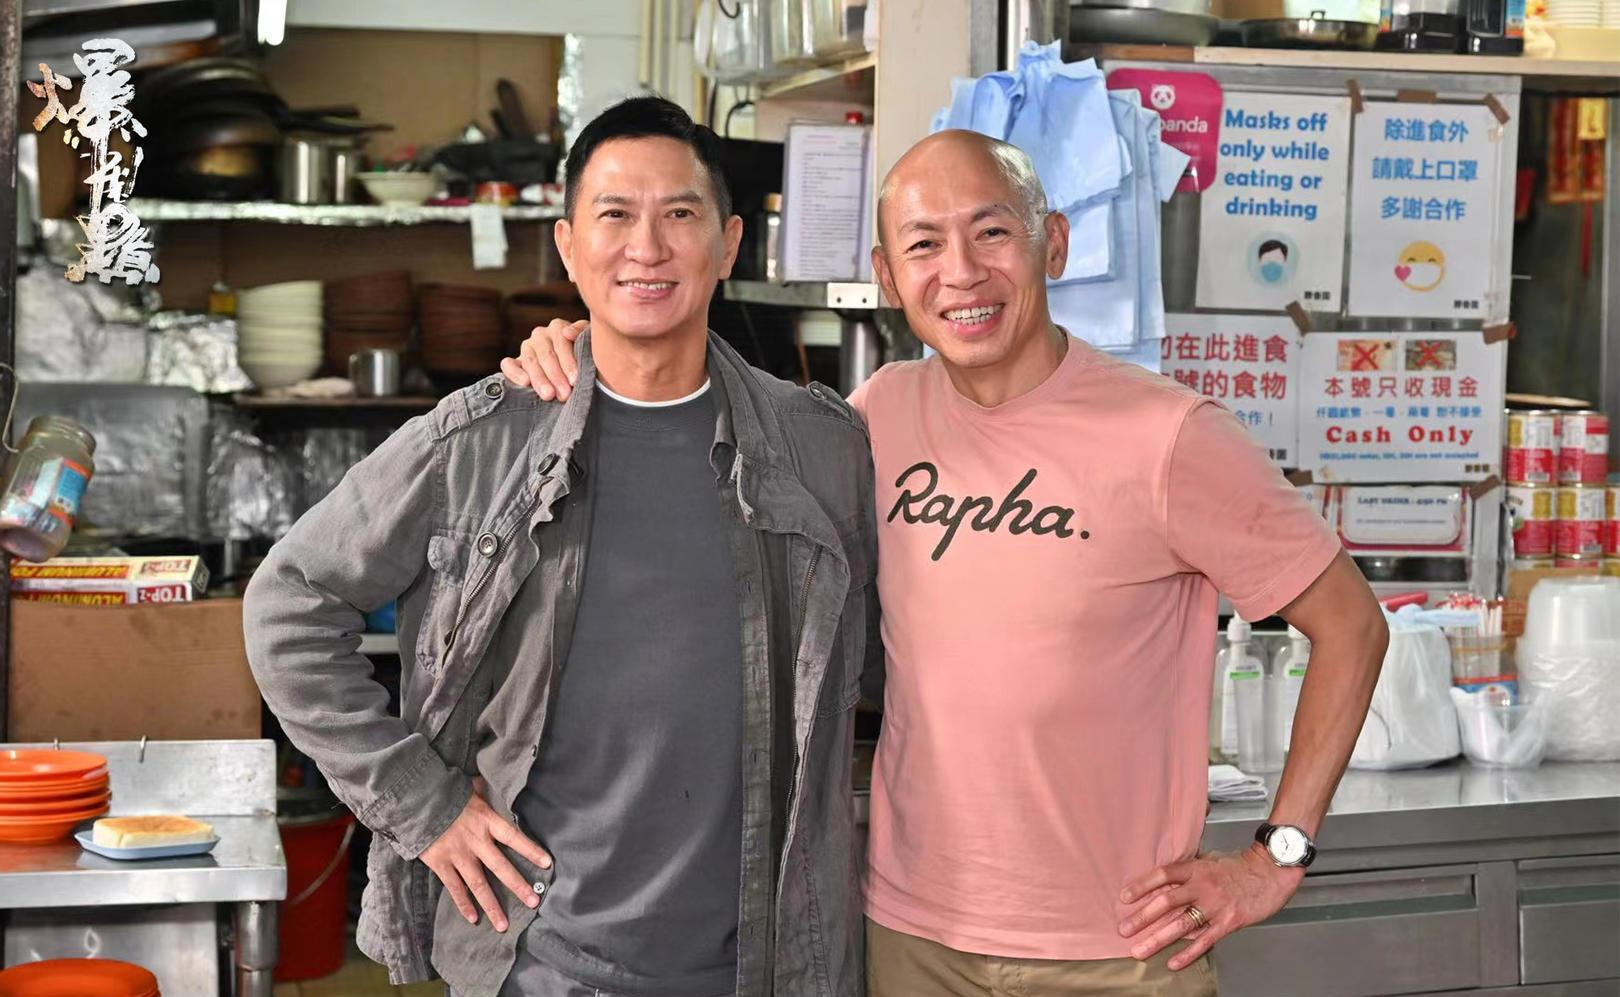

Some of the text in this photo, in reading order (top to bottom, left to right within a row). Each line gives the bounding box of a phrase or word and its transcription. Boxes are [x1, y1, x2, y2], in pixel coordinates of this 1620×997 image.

[1225, 109, 1328, 131] Masks off
[1384, 118, 1470, 142] 除進食外
[1220, 138, 1330, 161] only while
[1224, 169, 1322, 191] eating or
[1372, 157, 1479, 181] 請戴上口罩
[1225, 196, 1318, 221] drinking
[1381, 196, 1467, 220] 多謝合作
[1324, 376, 1479, 398] 本號只收現金
[1325, 425, 1474, 446] Cash Only
[887, 461, 1090, 561] Rapha.
